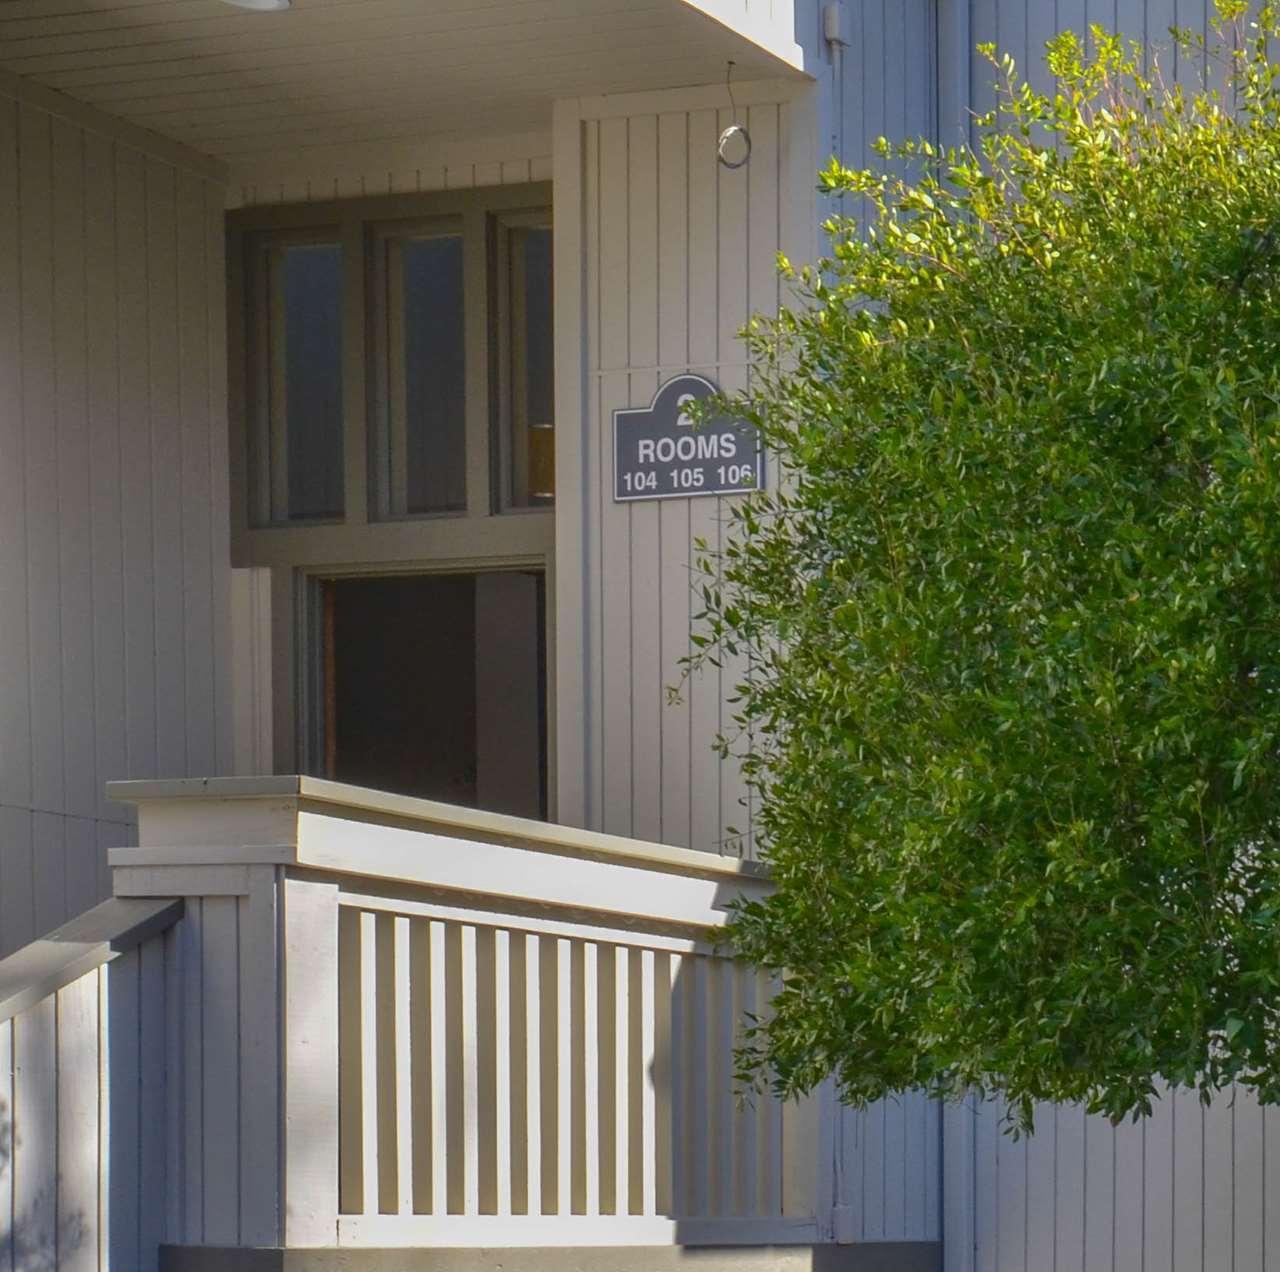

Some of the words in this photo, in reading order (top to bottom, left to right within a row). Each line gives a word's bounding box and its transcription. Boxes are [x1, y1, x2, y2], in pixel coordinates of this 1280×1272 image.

[638, 433, 737, 464] ROOMS
[623, 471, 657, 491] 104
[670, 468, 704, 488] 105
